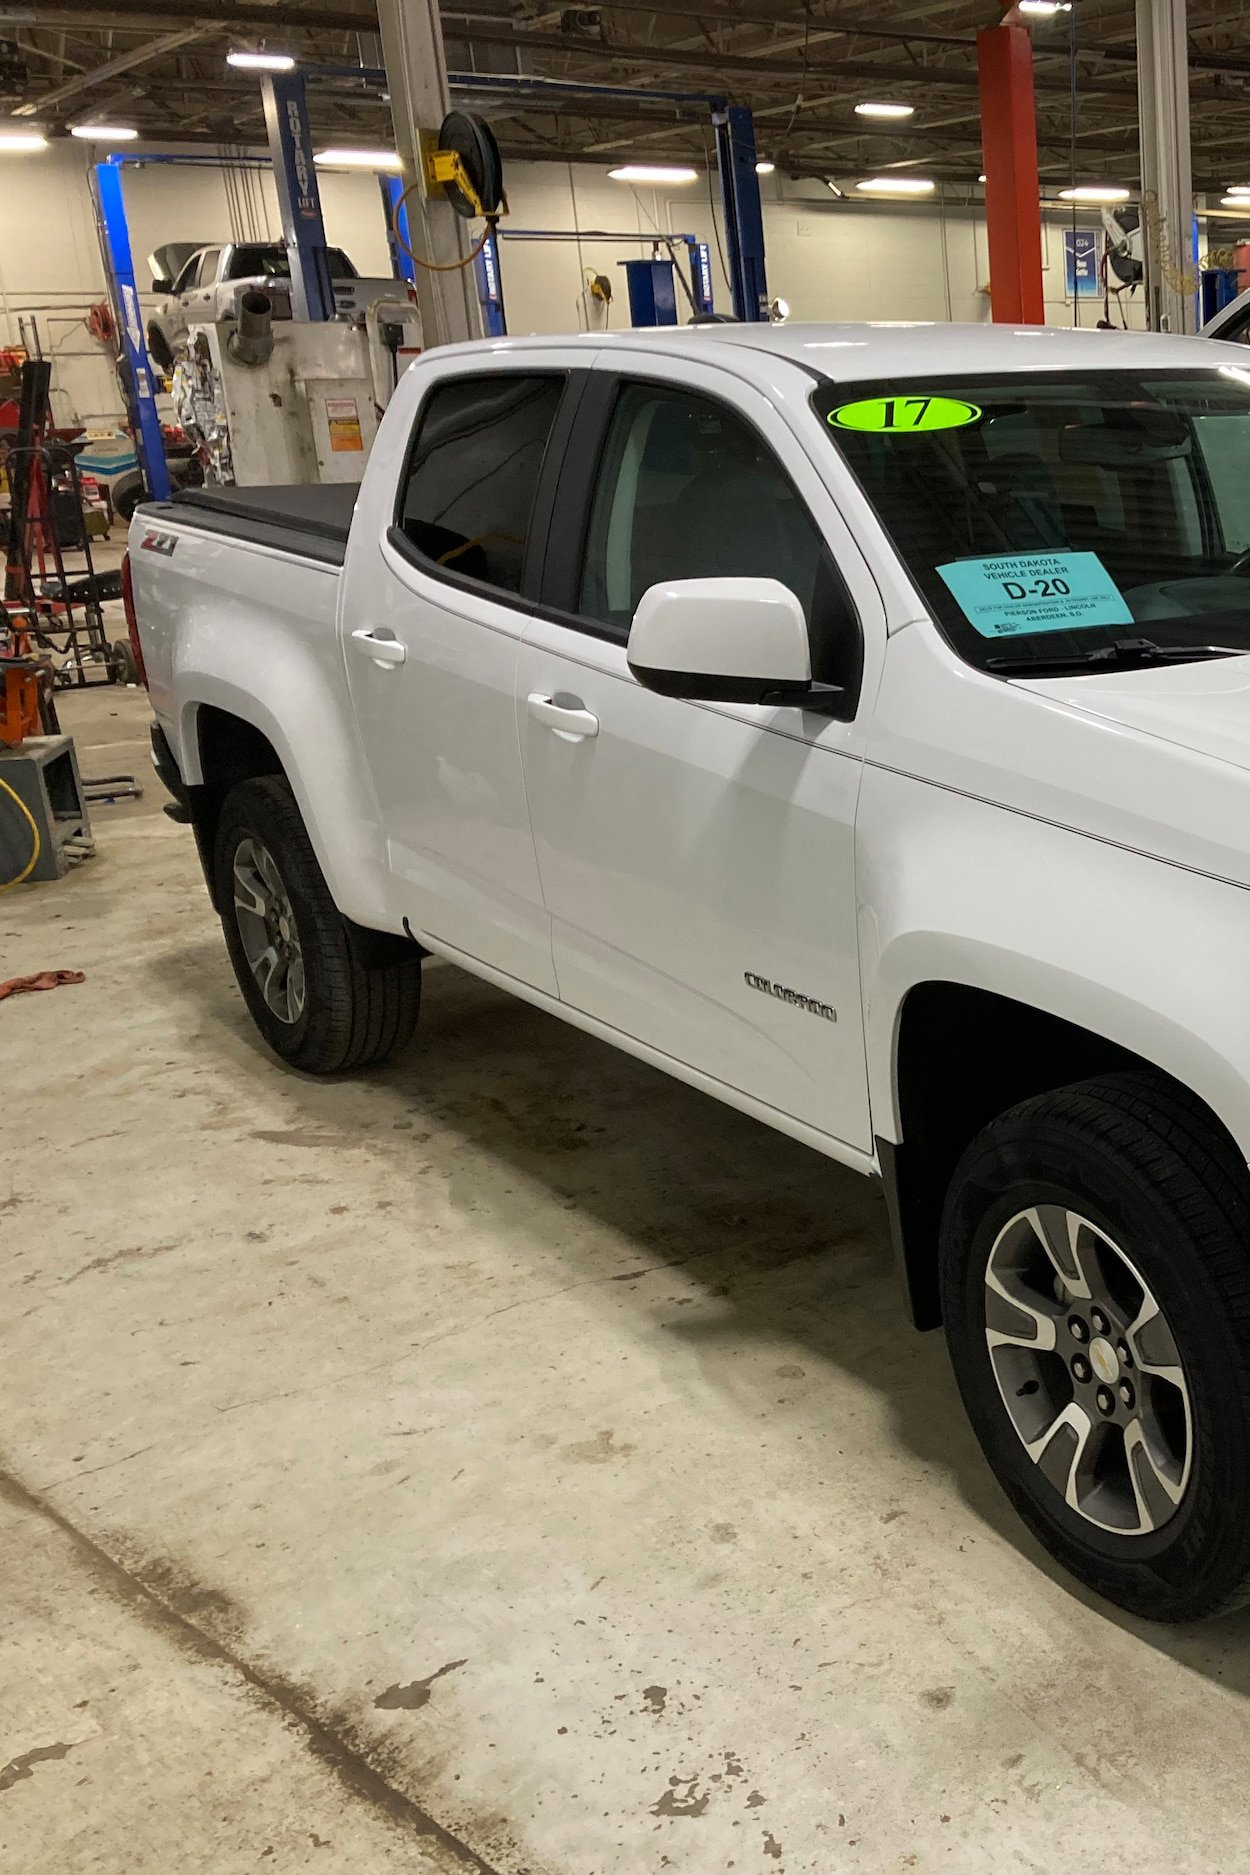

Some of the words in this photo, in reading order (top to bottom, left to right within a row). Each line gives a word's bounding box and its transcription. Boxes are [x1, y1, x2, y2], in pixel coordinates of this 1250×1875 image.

[286, 100, 309, 196] ROTARY
[1073, 238, 1089, 247] 024
[877, 398, 931, 429] 17
[982, 562, 1018, 571] SOUTH
[1019, 558, 1061, 568] DAKOTA
[984, 570, 1028, 580] VEHICLE
[1029, 567, 1069, 577] DEALER
[1002, 578, 1071, 600] D-20
[1004, 609, 1037, 617] PIERSON
[1037, 606, 1060, 615] FORD
[1063, 602, 1097, 611] LINCOLN
[743, 970, 838, 1023] COLORADO
